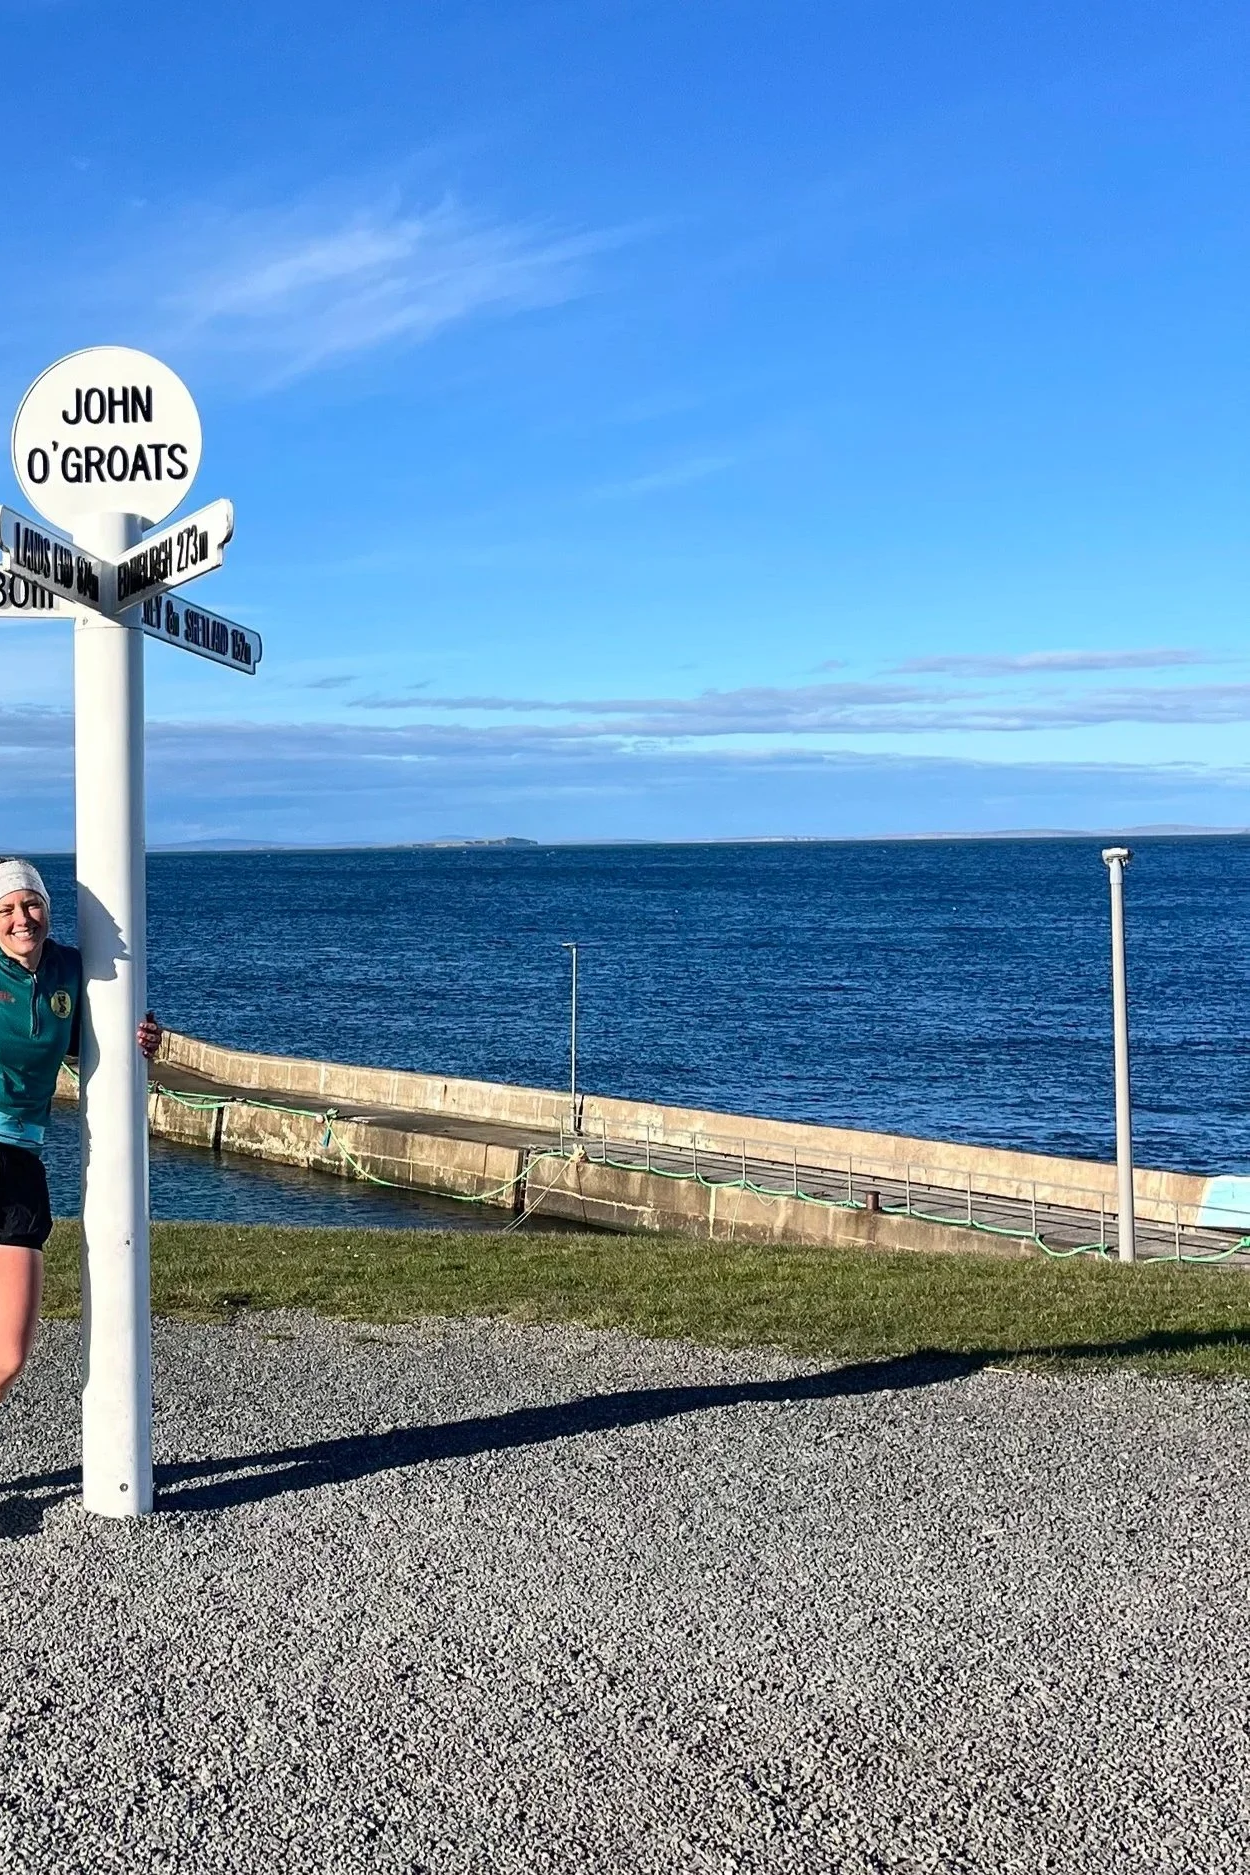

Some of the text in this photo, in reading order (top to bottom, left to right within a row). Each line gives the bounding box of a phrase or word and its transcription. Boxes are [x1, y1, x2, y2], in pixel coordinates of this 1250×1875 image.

[61, 385, 152, 425] JOHN
[27, 441, 188, 484] O'GROATS
[14, 521, 51, 579] LANDS
[53, 542, 73, 589] END
[117, 524, 208, 601] EDINBURGH 273m
[184, 608, 228, 656] SHETLAND
